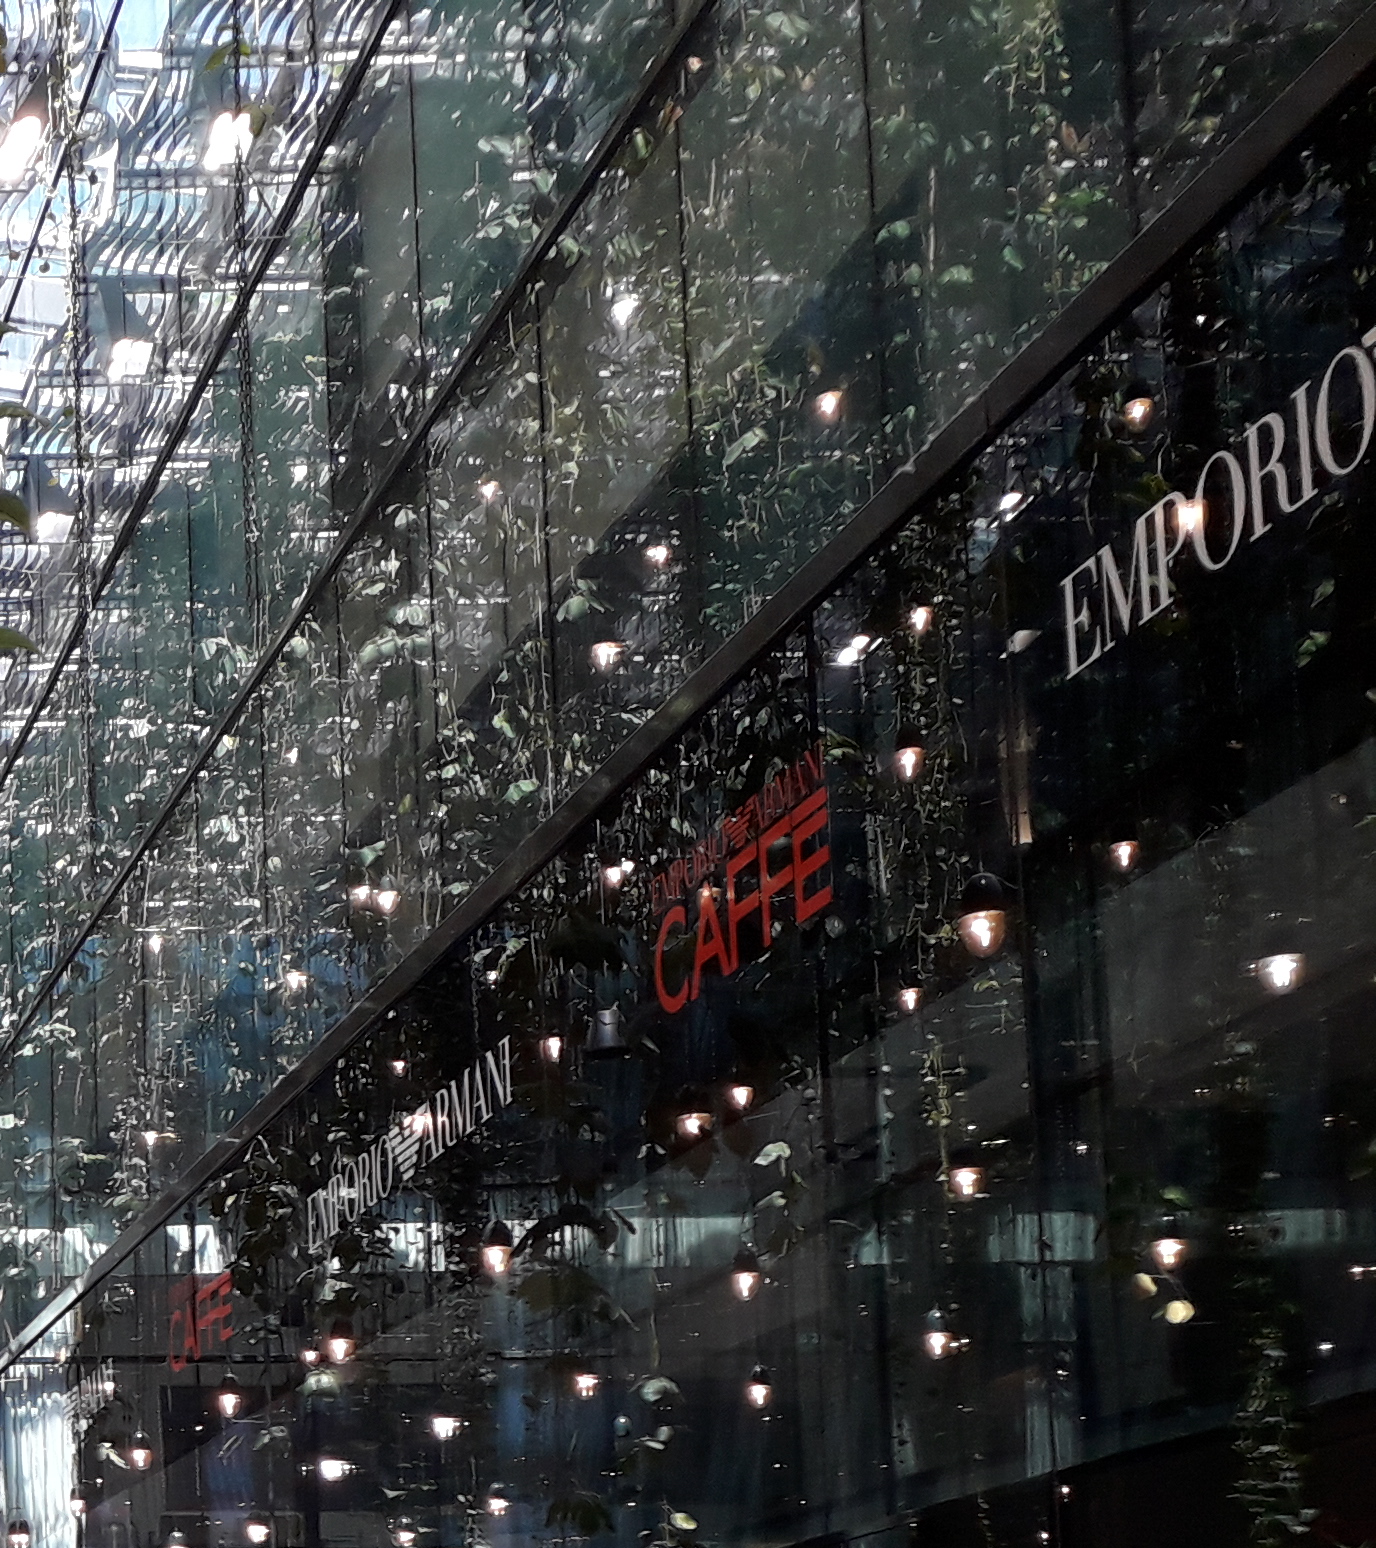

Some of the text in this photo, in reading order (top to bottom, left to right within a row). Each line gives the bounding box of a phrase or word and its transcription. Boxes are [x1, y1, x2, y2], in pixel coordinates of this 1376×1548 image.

[1060, 344, 1376, 680] EMPORIO
[654, 786, 833, 1014] CAFFE
[306, 1035, 513, 1255] EMPORIO ARMANI
